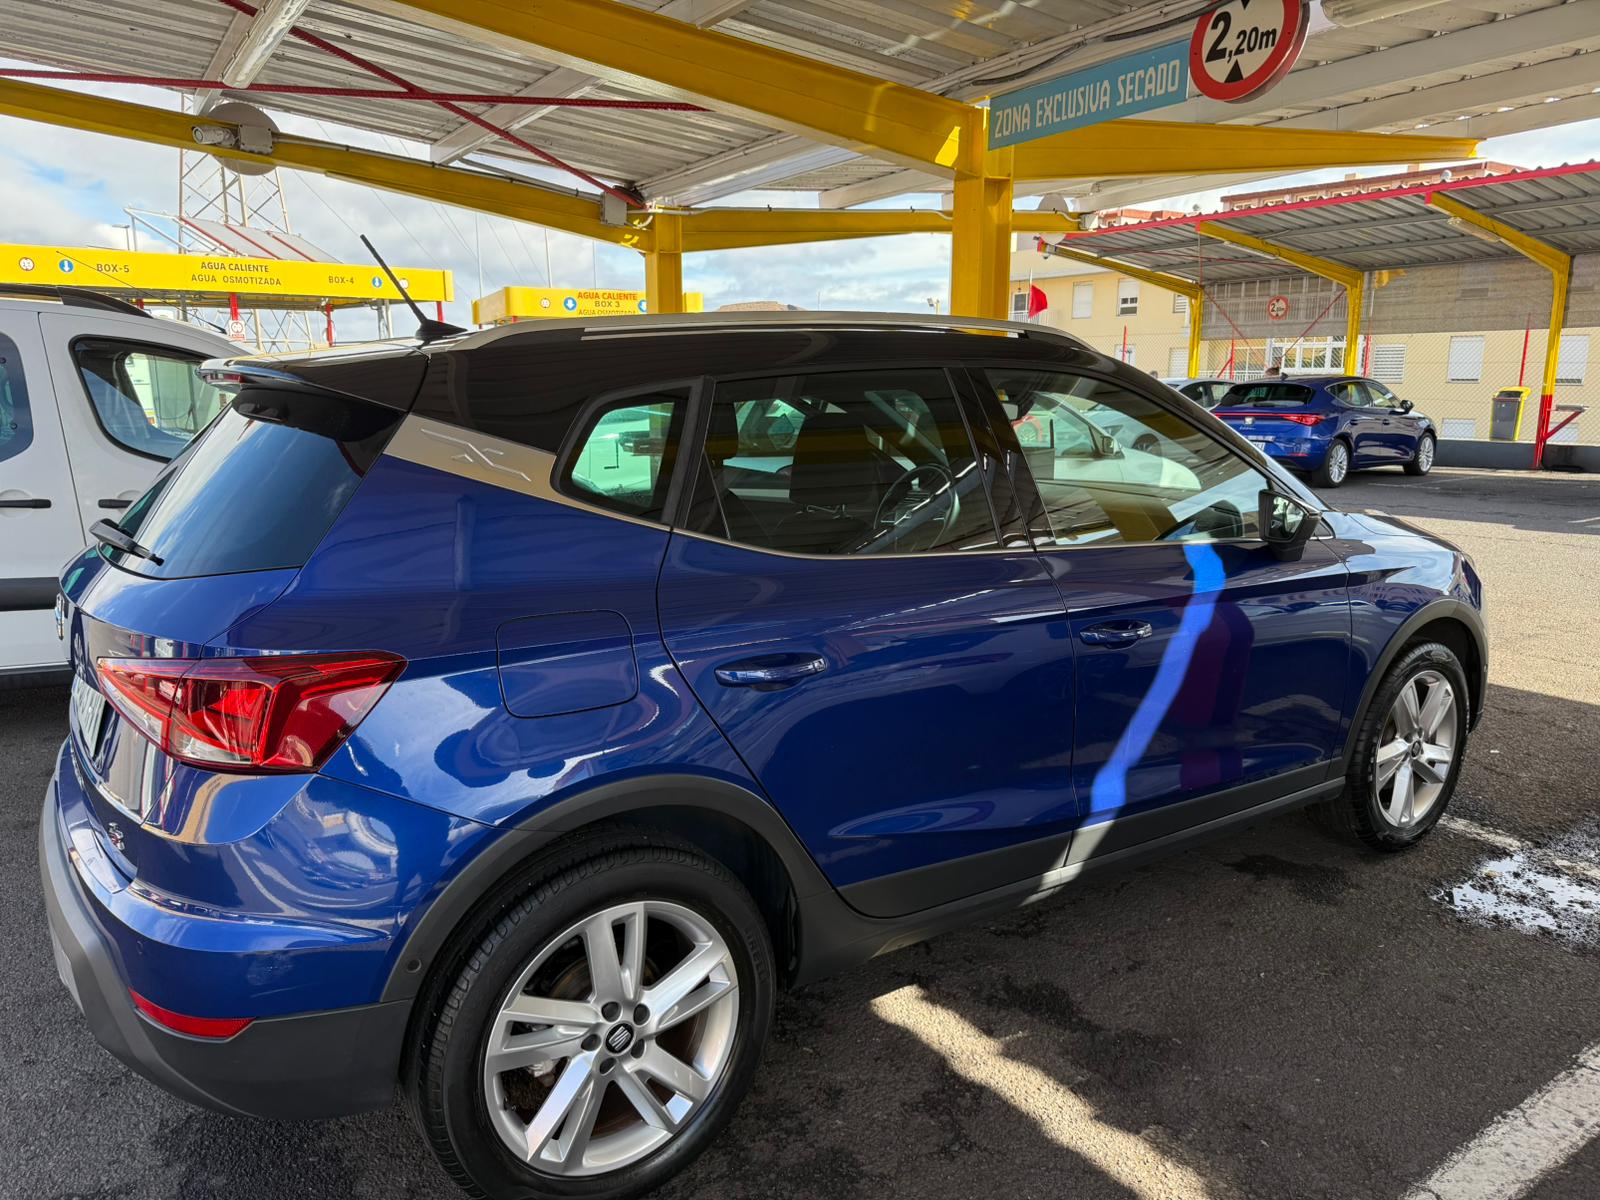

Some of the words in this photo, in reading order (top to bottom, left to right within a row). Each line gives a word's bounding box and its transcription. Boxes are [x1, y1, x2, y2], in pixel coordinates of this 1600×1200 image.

[1205, 11, 1277, 63] 2,20m
[994, 102, 1031, 138] ZONA
[1035, 79, 1111, 128] EXCLUSIVA
[1116, 59, 1180, 107] SECADO
[96, 263, 130, 273] BOX-5
[200, 261, 226, 271] AGUA
[228, 262, 269, 273] CALIENTE
[191, 274, 217, 283] AGUA
[222, 275, 282, 286] OSMOTIZADA
[328, 275, 354, 284] BOX-4
[577, 291, 600, 300] AGUA
[602, 292, 638, 301] CALIENTE
[594, 300, 612, 308] BOX
